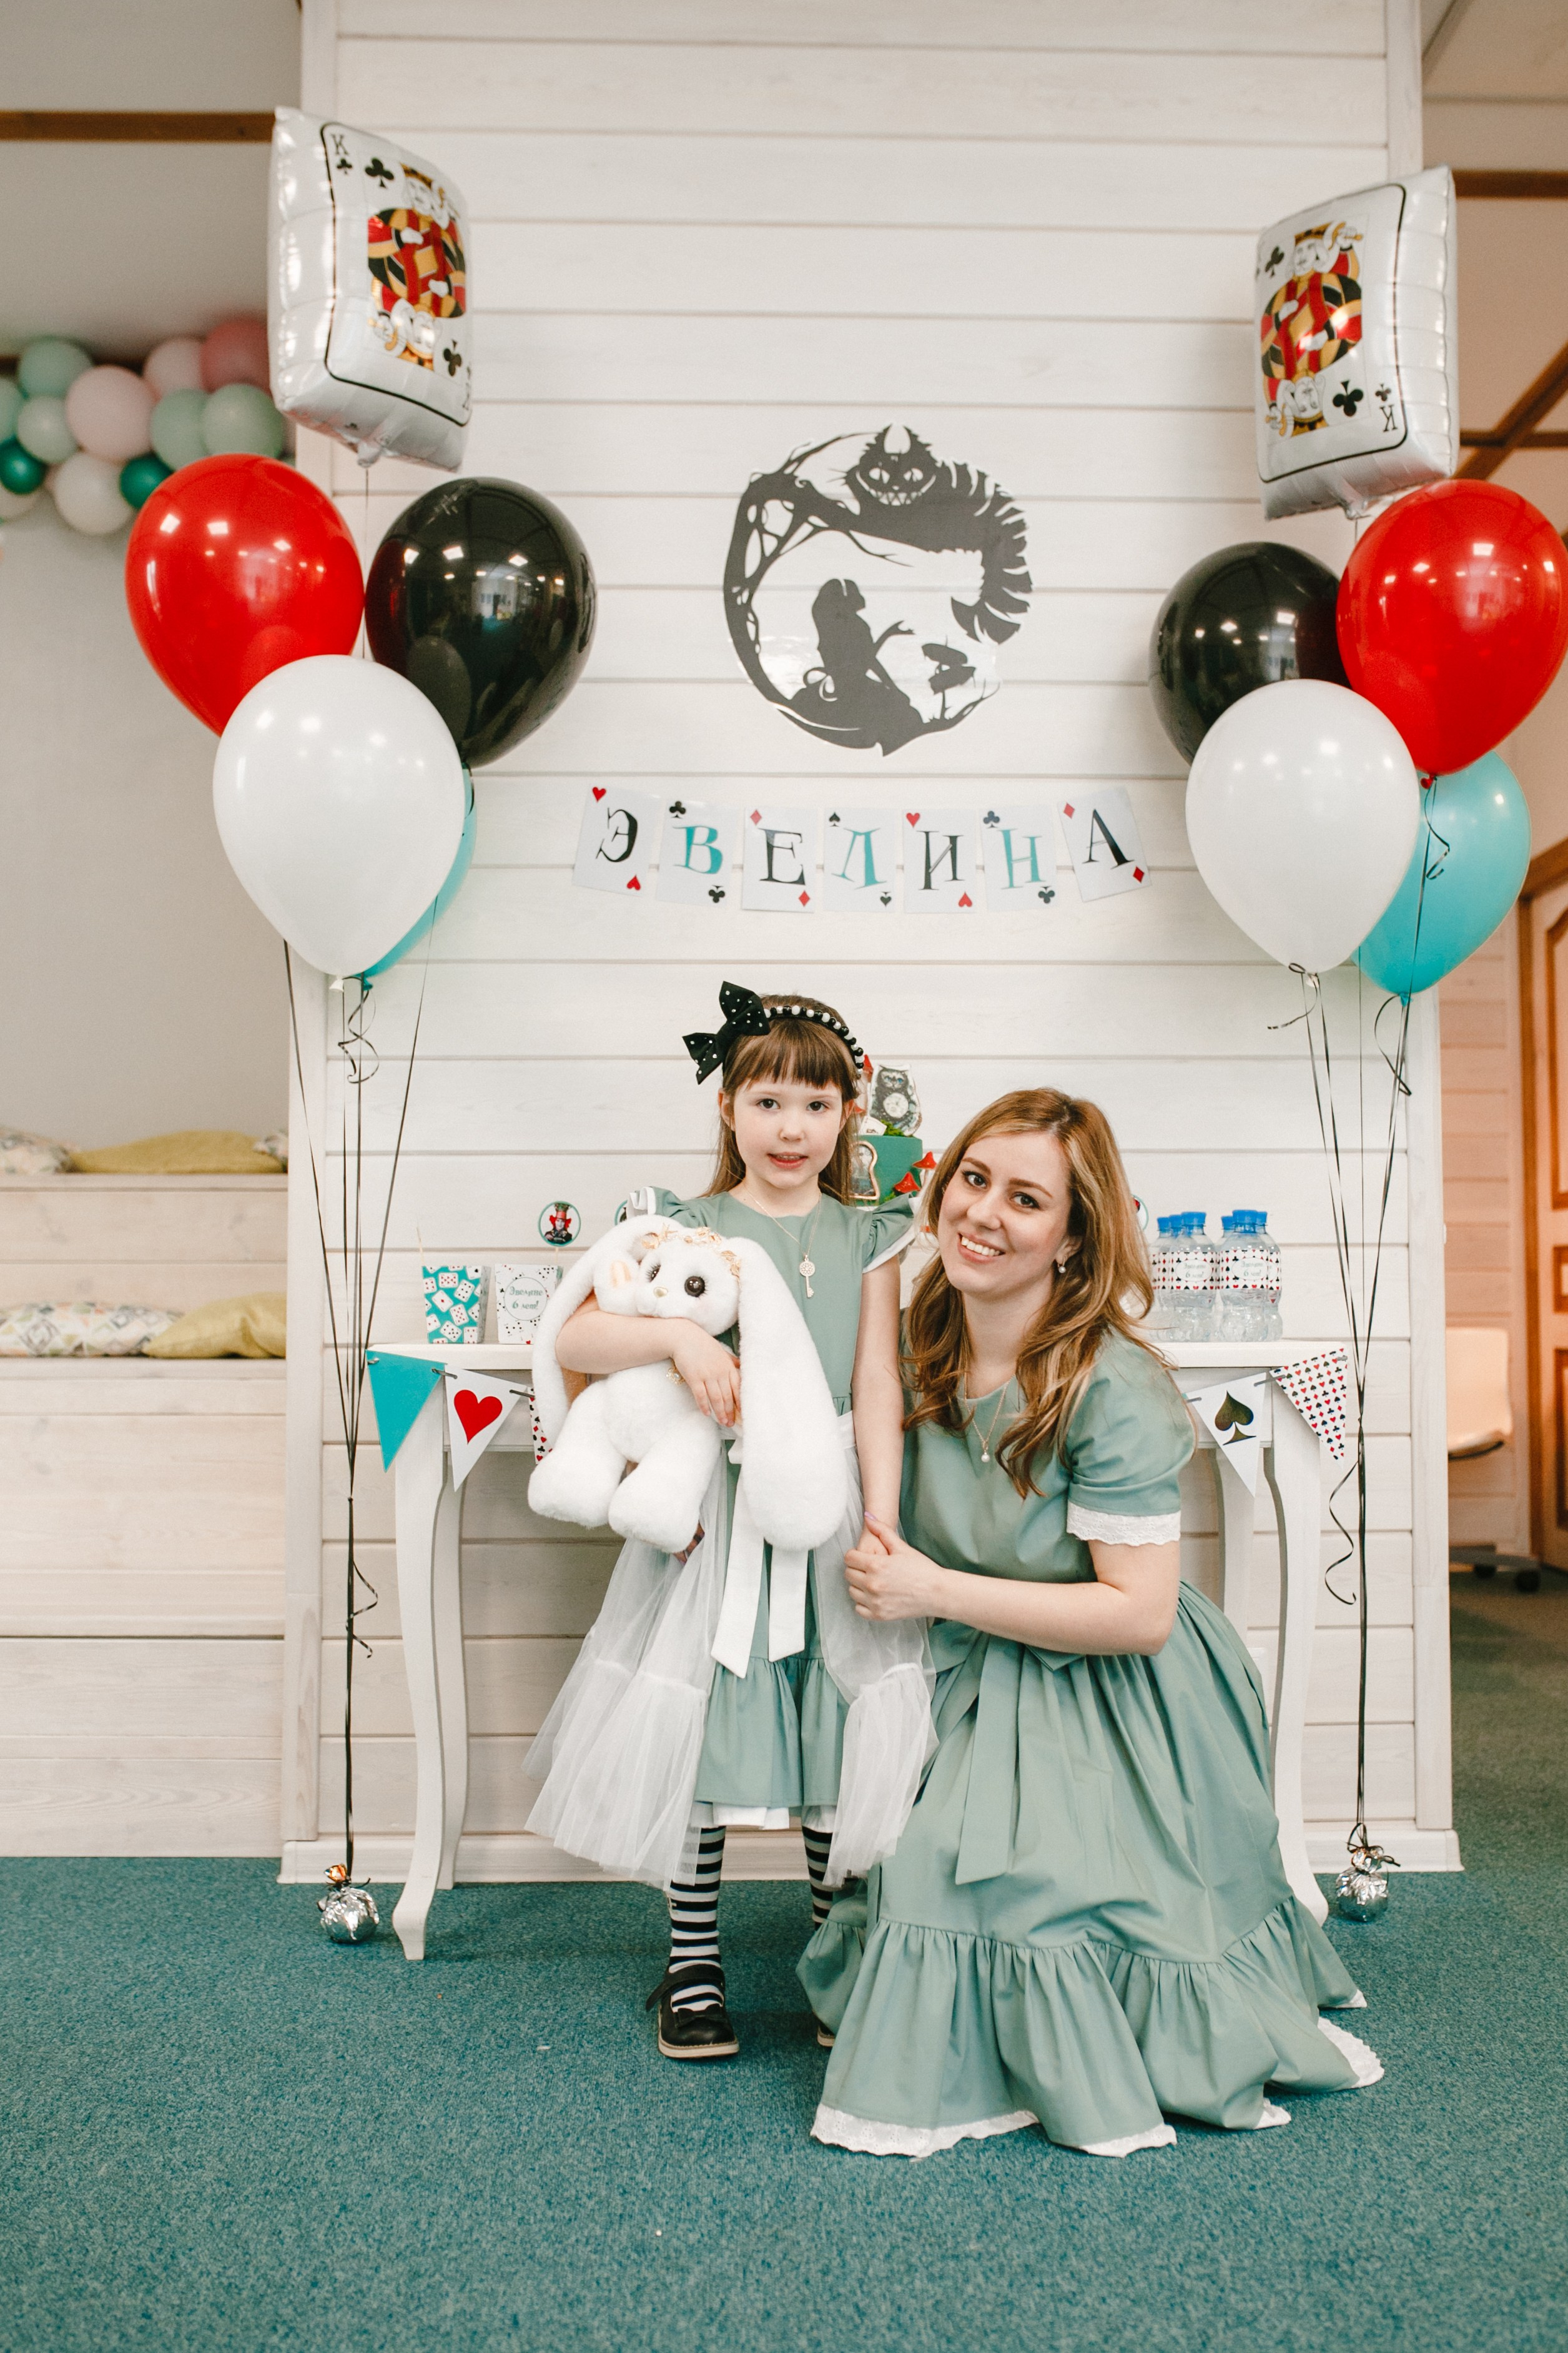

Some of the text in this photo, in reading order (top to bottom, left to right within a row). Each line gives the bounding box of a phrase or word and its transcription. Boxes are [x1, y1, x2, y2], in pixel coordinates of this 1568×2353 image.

[331, 134, 348, 155] K
[1380, 405, 1398, 432] K
[595, 807, 1135, 891] ЭВЕЛИНА
[513, 1299, 519, 1309] 6
